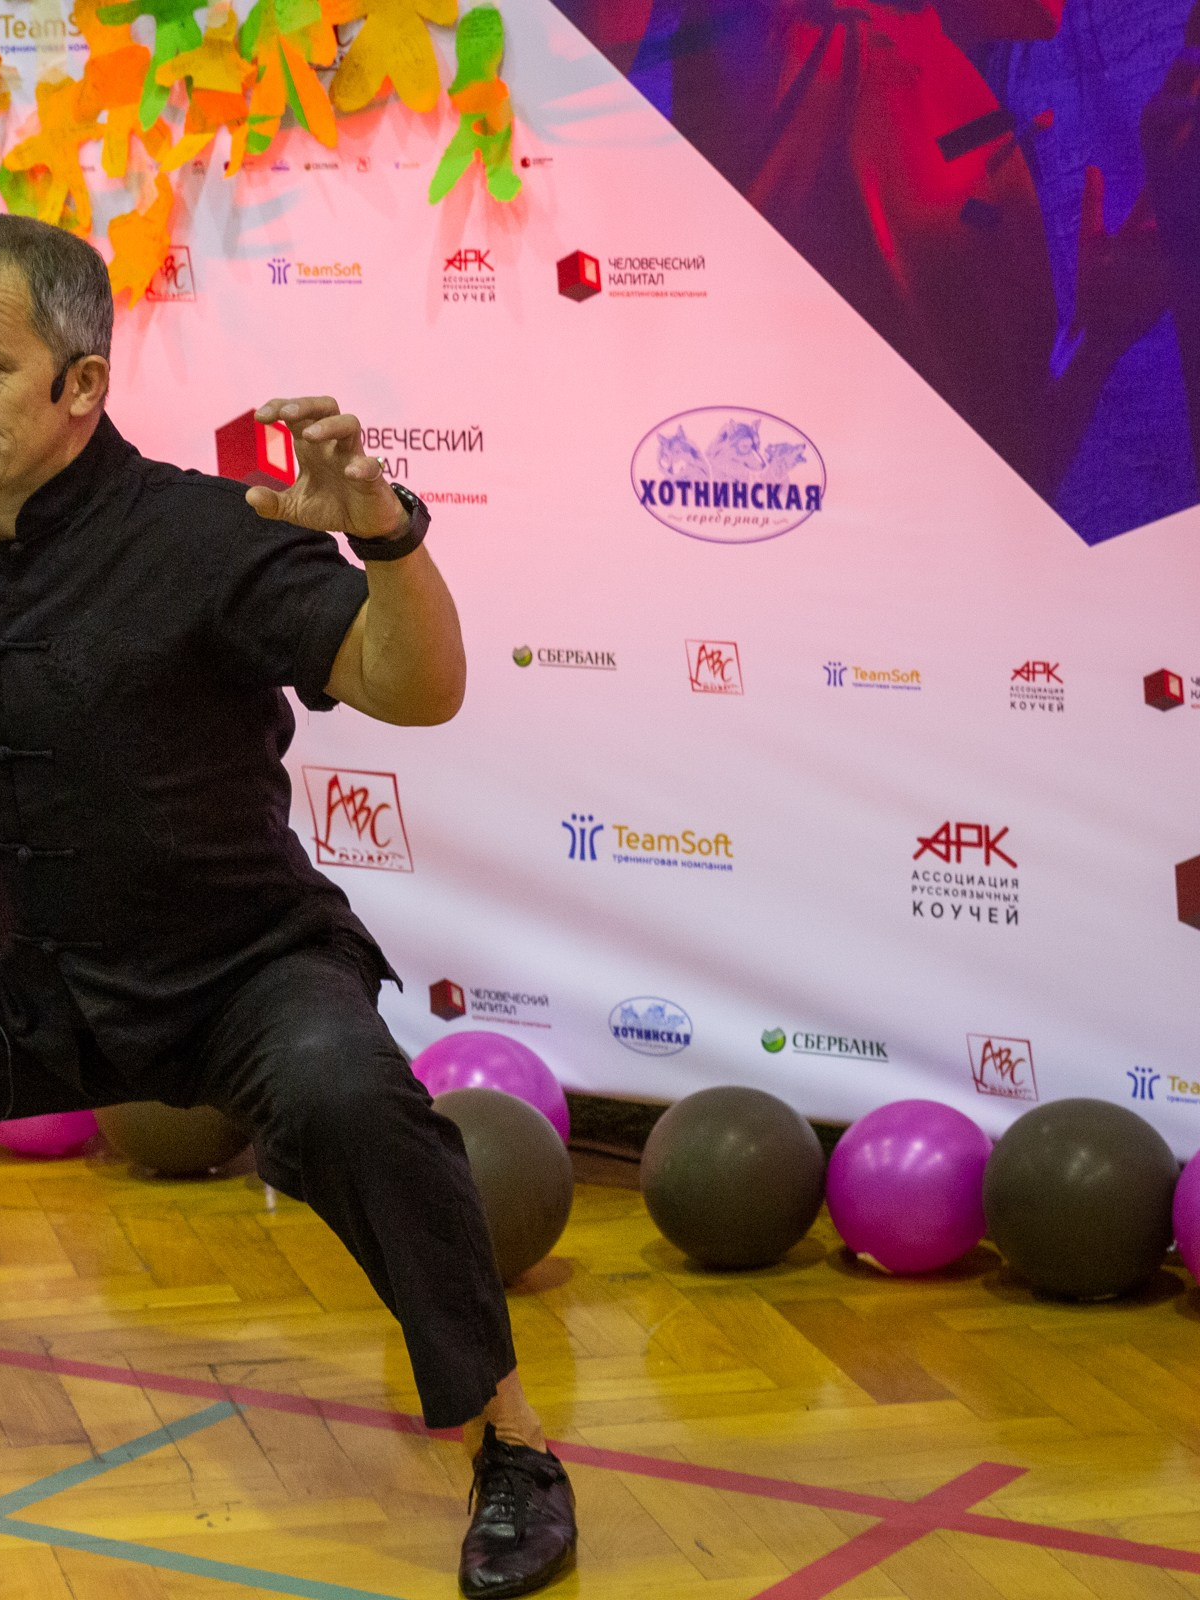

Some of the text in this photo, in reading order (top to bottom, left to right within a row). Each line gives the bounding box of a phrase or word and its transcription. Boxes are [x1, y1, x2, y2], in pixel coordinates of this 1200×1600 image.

[0, 12, 81, 39] TeamS
[296, 262, 362, 277] TeamSoft
[608, 255, 705, 270] ЧЕЛОВЕЧЕСКИЙ
[608, 272, 665, 285] КАПИТАЛ
[443, 290, 495, 302] КОУЧЕЙ
[640, 479, 822, 512] ХОТНИНСКАЯ
[686, 508, 770, 527] серебряная
[537, 647, 617, 667] СБЕРБАНК
[852, 666, 921, 684] TeamSoft
[1010, 700, 1064, 712] КОУЧЕЙ
[612, 824, 734, 858] TeamSoft
[612, 854, 733, 871] тренинговая компания
[911, 869, 1019, 889] АССОЦИАЦИЯ
[911, 884, 1019, 902] РУССКОЯЗЫЧНЫХ
[912, 900, 1018, 926] КОУЧЕЙ
[470, 987, 549, 1007] ЧЕЛОВЕЧЕСКИЙ
[471, 1001, 517, 1015] КАПИТАЛ
[613, 1026, 690, 1046] ХОТНИНСКАЯ
[792, 1032, 888, 1058] СБЕРБАНК
